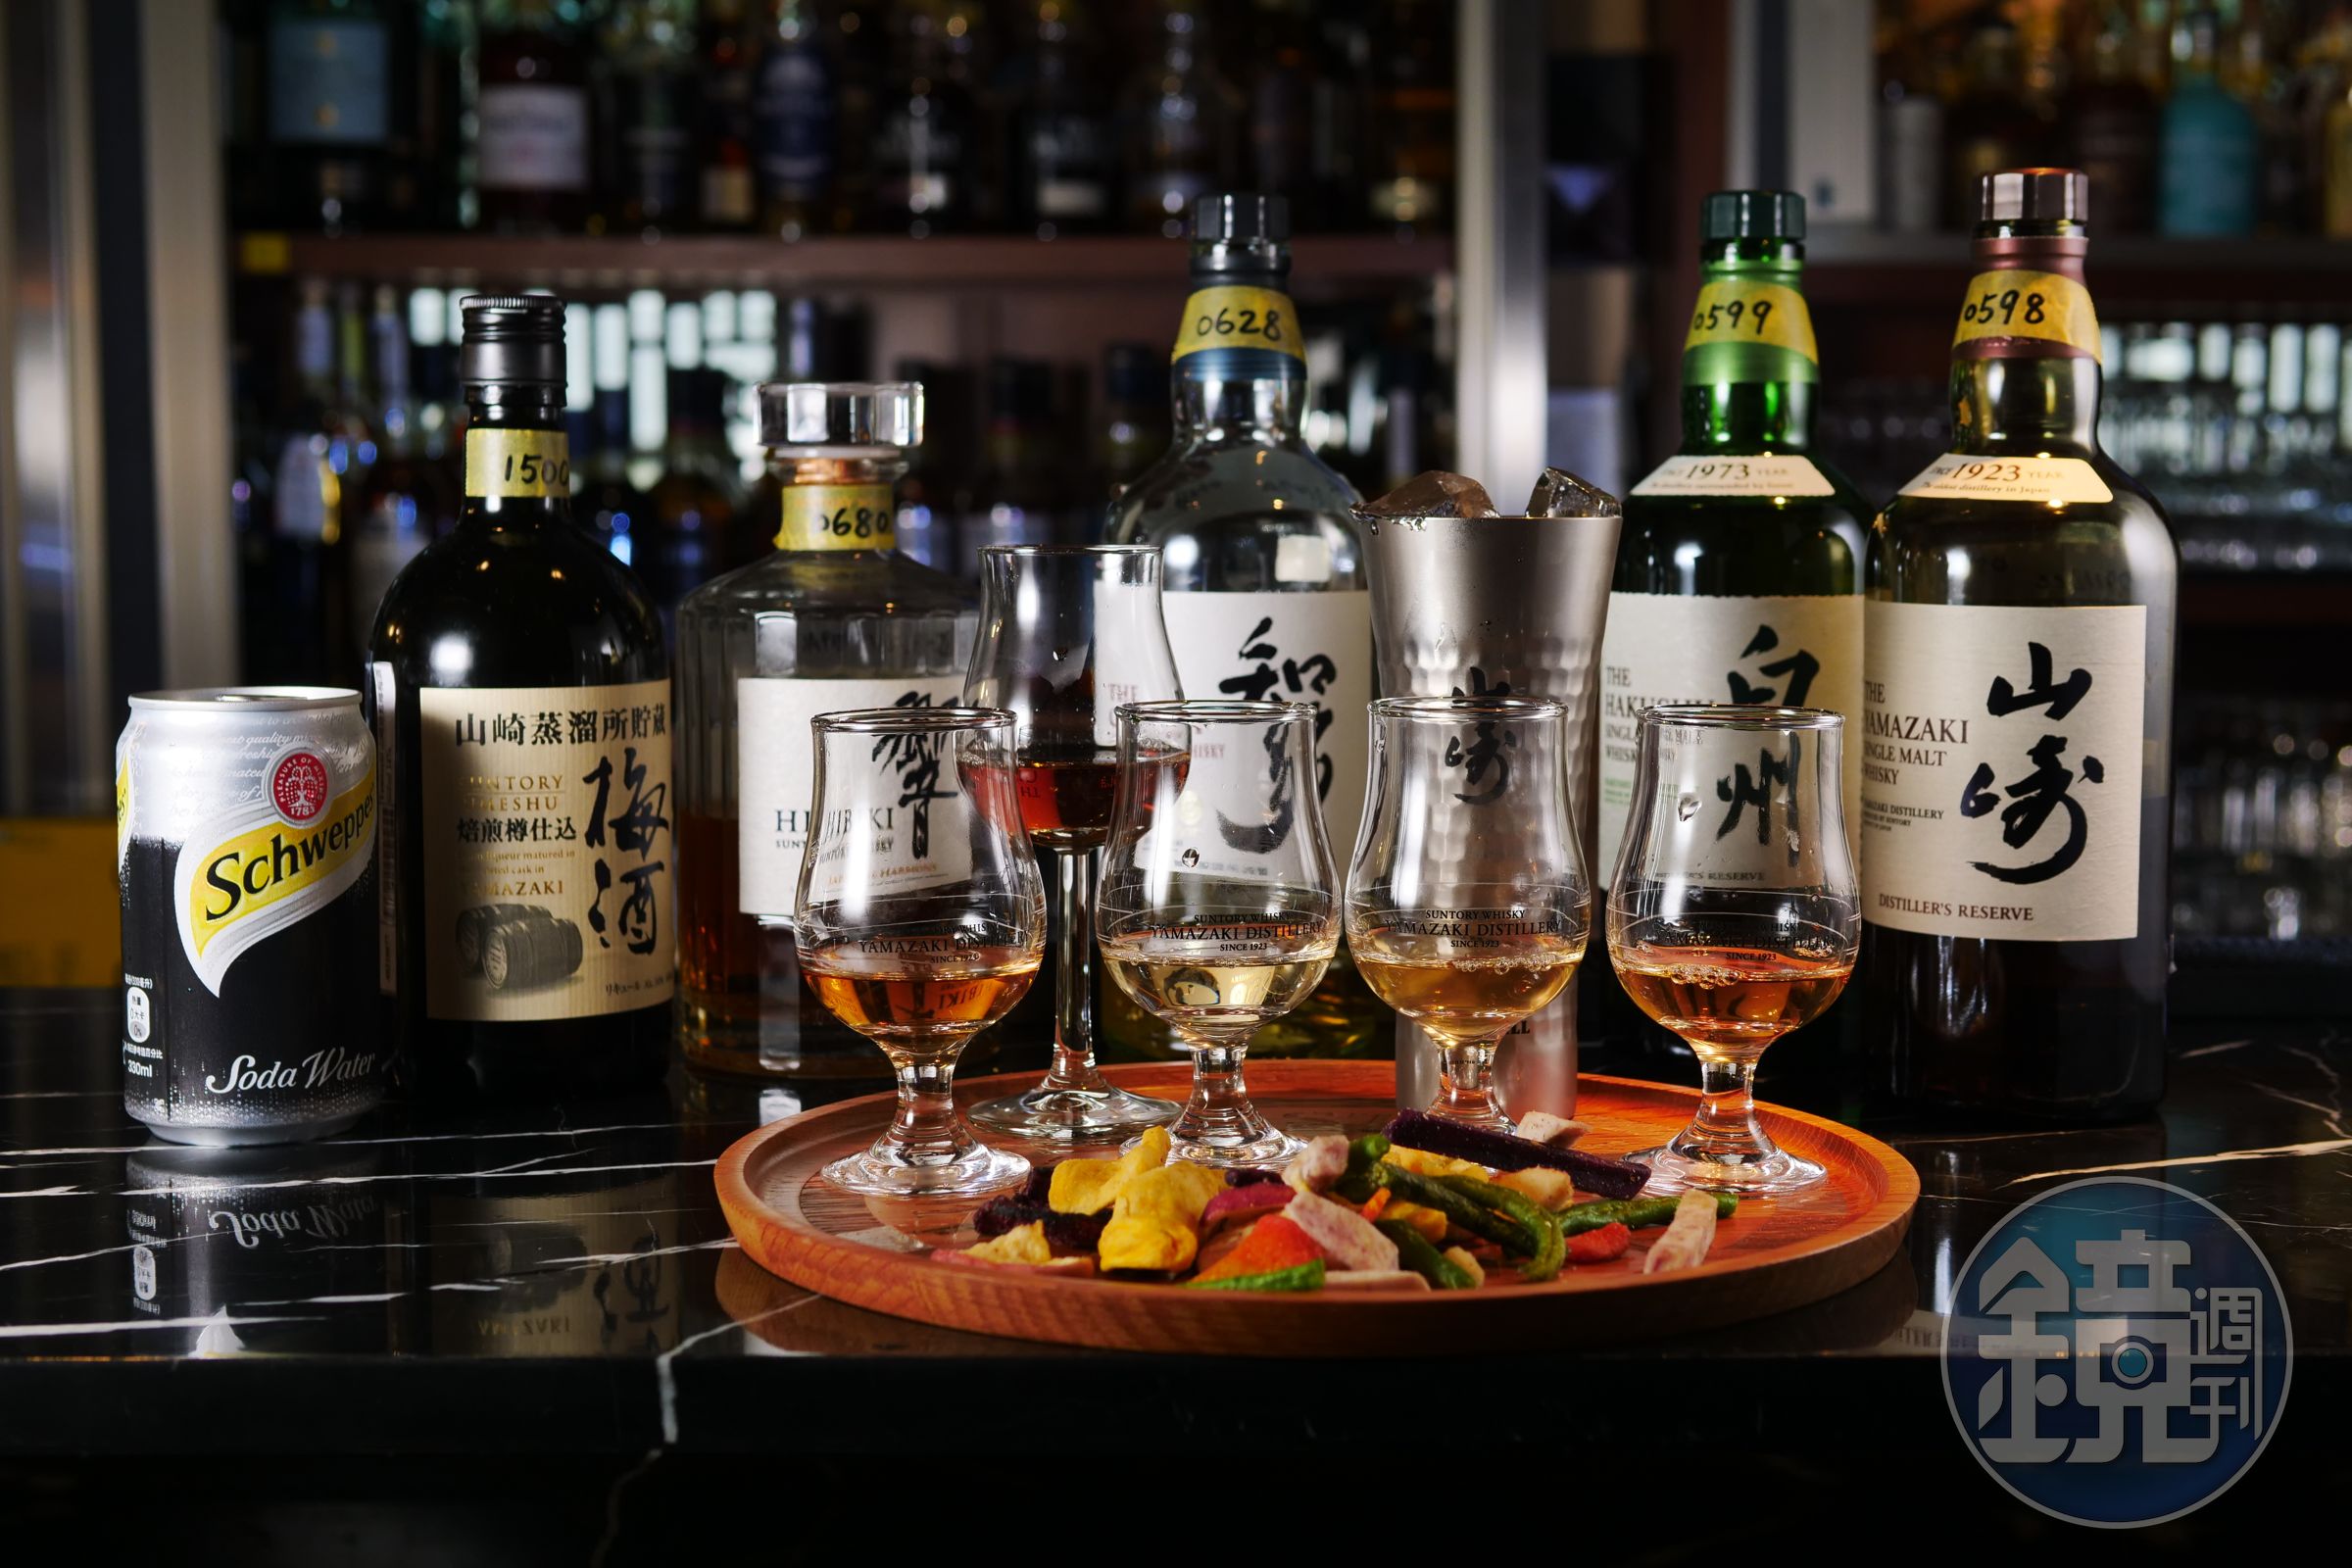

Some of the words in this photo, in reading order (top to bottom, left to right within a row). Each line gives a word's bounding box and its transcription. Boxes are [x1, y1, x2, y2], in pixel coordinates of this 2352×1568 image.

[1964, 289, 2045, 324] 0598
[1197, 308, 1281, 341] 0628
[1693, 300, 1772, 335] 0599
[505, 454, 569, 486] 1500
[1686, 463, 1750, 480] 1973
[1952, 462, 2021, 482] 1923
[1606, 666, 1631, 686] THE
[1864, 681, 1886, 704] THE
[1605, 693, 1715, 718] HAKU
[456, 703, 666, 747] 山崎蒸溜所貯蔵
[1863, 709, 1970, 745] YAMAZAKI
[1898, 747, 1947, 767] MALT
[1960, 641, 2105, 885] 山崎
[457, 774, 564, 791] UNTORY
[464, 796, 558, 812] MESHU
[1890, 805, 1945, 820] DISTILLERY
[460, 880, 564, 897] MAZAKI
[1425, 909, 1478, 920] SUNTORY
[1481, 909, 1526, 919] WHISKY
[1879, 893, 1952, 917] DISTILLER'S
[1958, 905, 2034, 922] RESERVE
[1194, 913, 1250, 924] SUNTORY
[1386, 919, 1471, 937] YAMAZAKI
[1476, 919, 1561, 937] DISTILLERY
[1152, 923, 1239, 941] YAMAZAKI
[1246, 921, 1322, 940] DISTILLERY
[859, 938, 949, 954] YAMAZAKI
[1219, 944, 1248, 953] SINCE
[1250, 942, 1268, 952] 1923
[1449, 939, 1479, 949] SINCE
[1481, 939, 1500, 949] 1923
[931, 955, 958, 964] SINCE
[1725, 952, 1754, 961] SINCE
[127, 1058, 153, 1078] 330ml
[206, 1054, 297, 1095] Soda
[301, 1046, 375, 1089] Water
